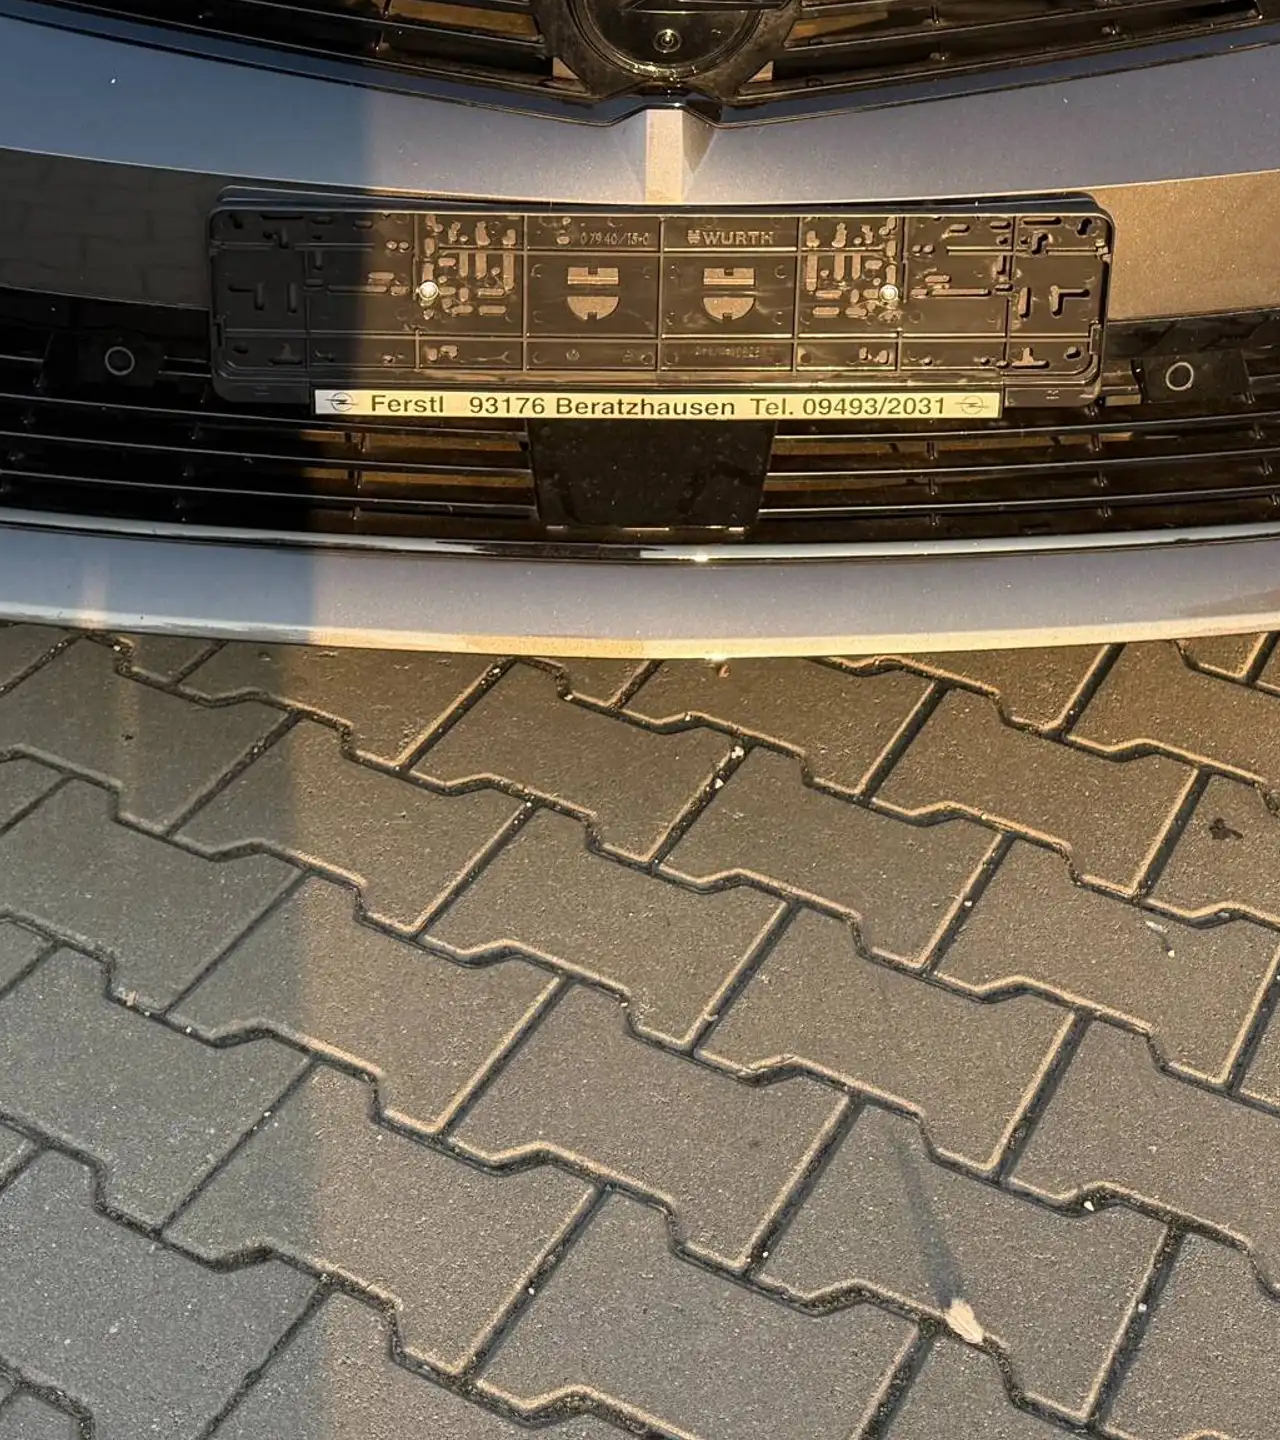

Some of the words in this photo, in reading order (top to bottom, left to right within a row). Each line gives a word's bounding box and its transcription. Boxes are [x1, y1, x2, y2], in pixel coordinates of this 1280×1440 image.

[371, 394, 445, 413] Ferstl
[469, 396, 546, 415] 93176
[555, 396, 736, 417] Beratzhausen
[749, 397, 795, 416] Tel.
[802, 395, 946, 417] 09493/2031
